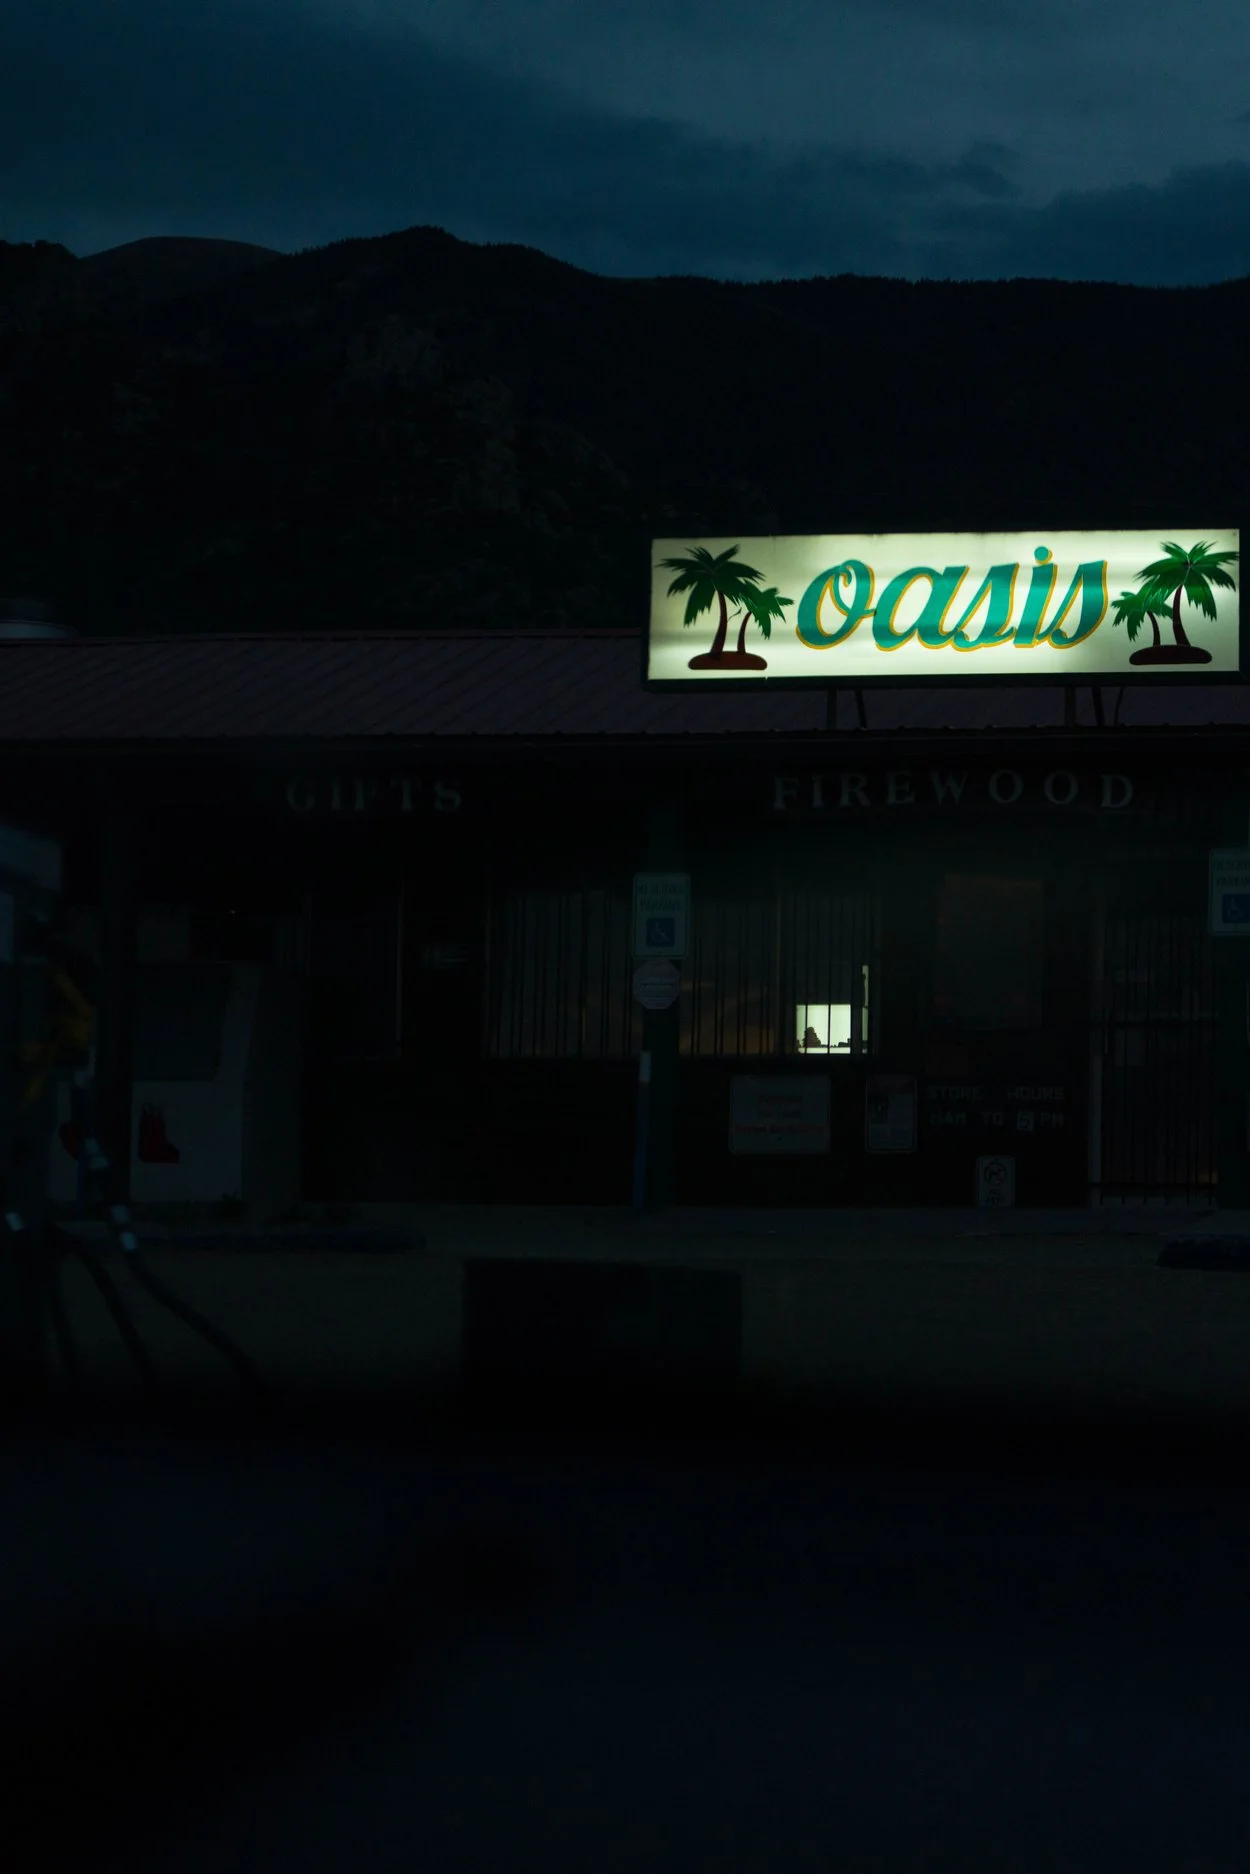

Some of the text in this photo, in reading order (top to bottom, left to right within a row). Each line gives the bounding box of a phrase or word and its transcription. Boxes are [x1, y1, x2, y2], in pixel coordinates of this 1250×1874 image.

[796, 546, 1110, 652] oasis
[285, 774, 463, 813] GIFTS
[771, 768, 1136, 811] FIREWOOD
